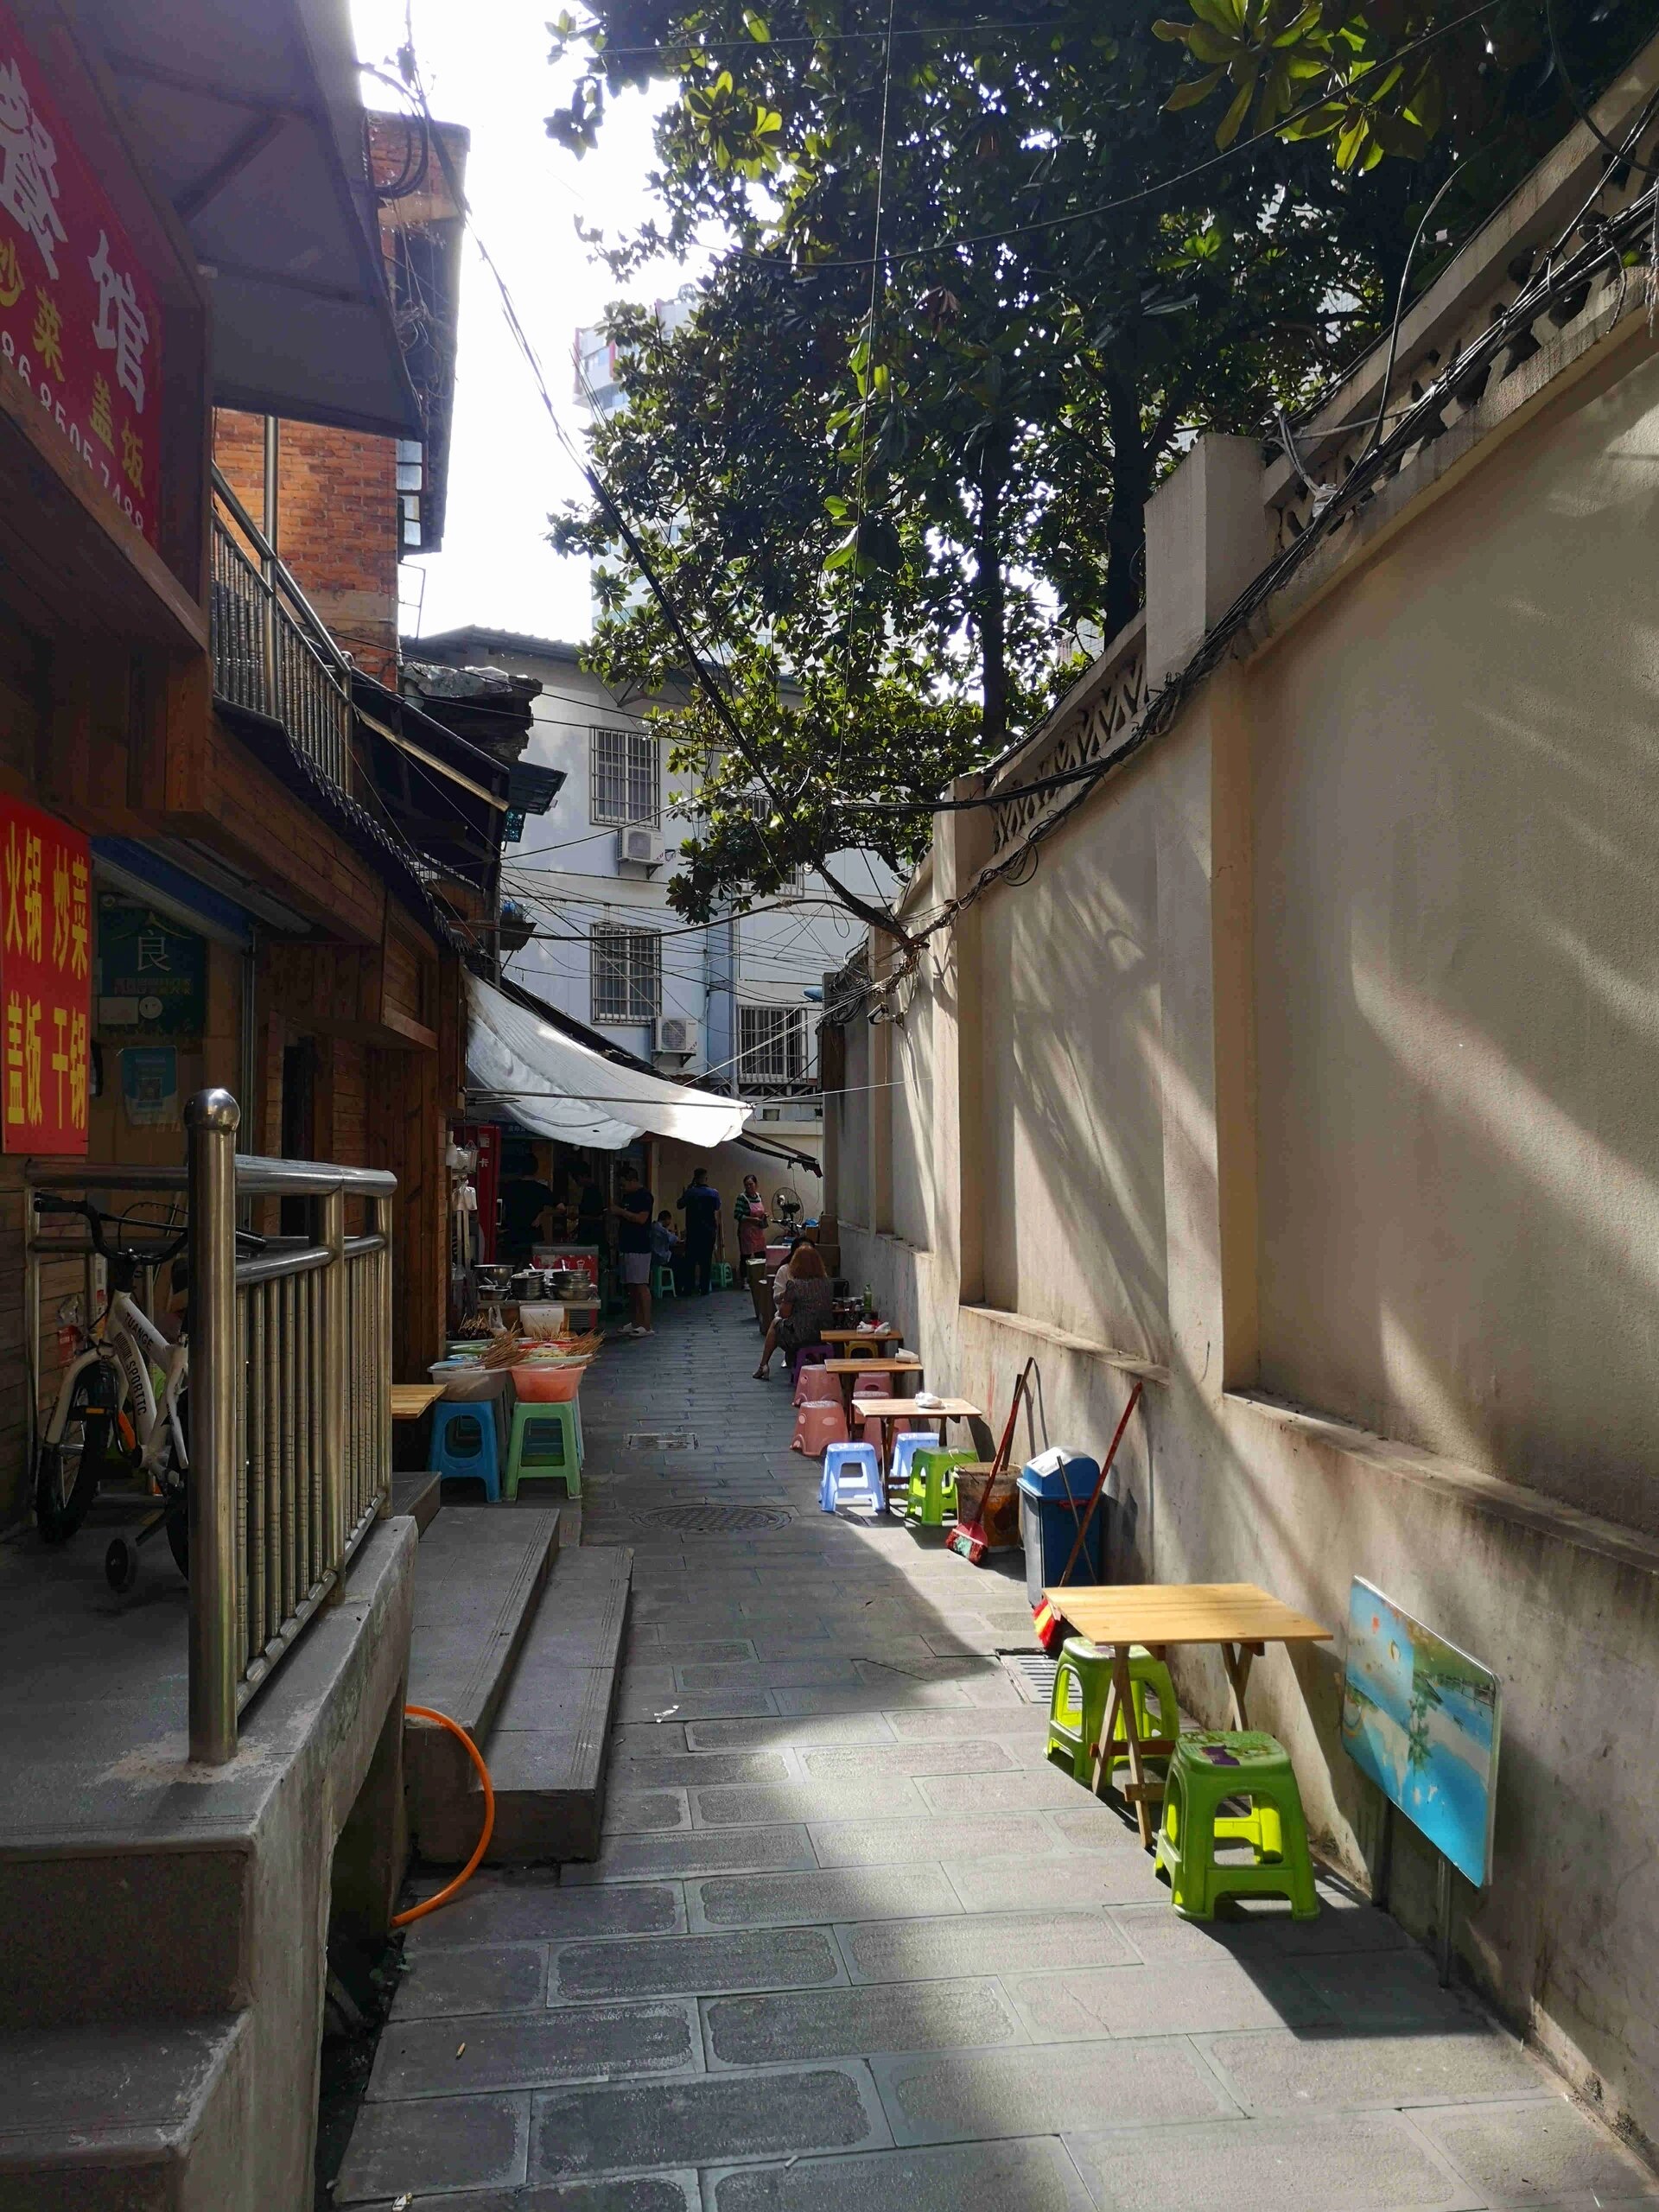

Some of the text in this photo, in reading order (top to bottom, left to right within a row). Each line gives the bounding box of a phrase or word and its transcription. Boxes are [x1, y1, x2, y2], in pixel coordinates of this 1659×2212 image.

[89, 372, 145, 499] 盖饭
[5, 821, 87, 980] 火锅 炒菜
[7, 989, 86, 1129] 盖饭 干锅
